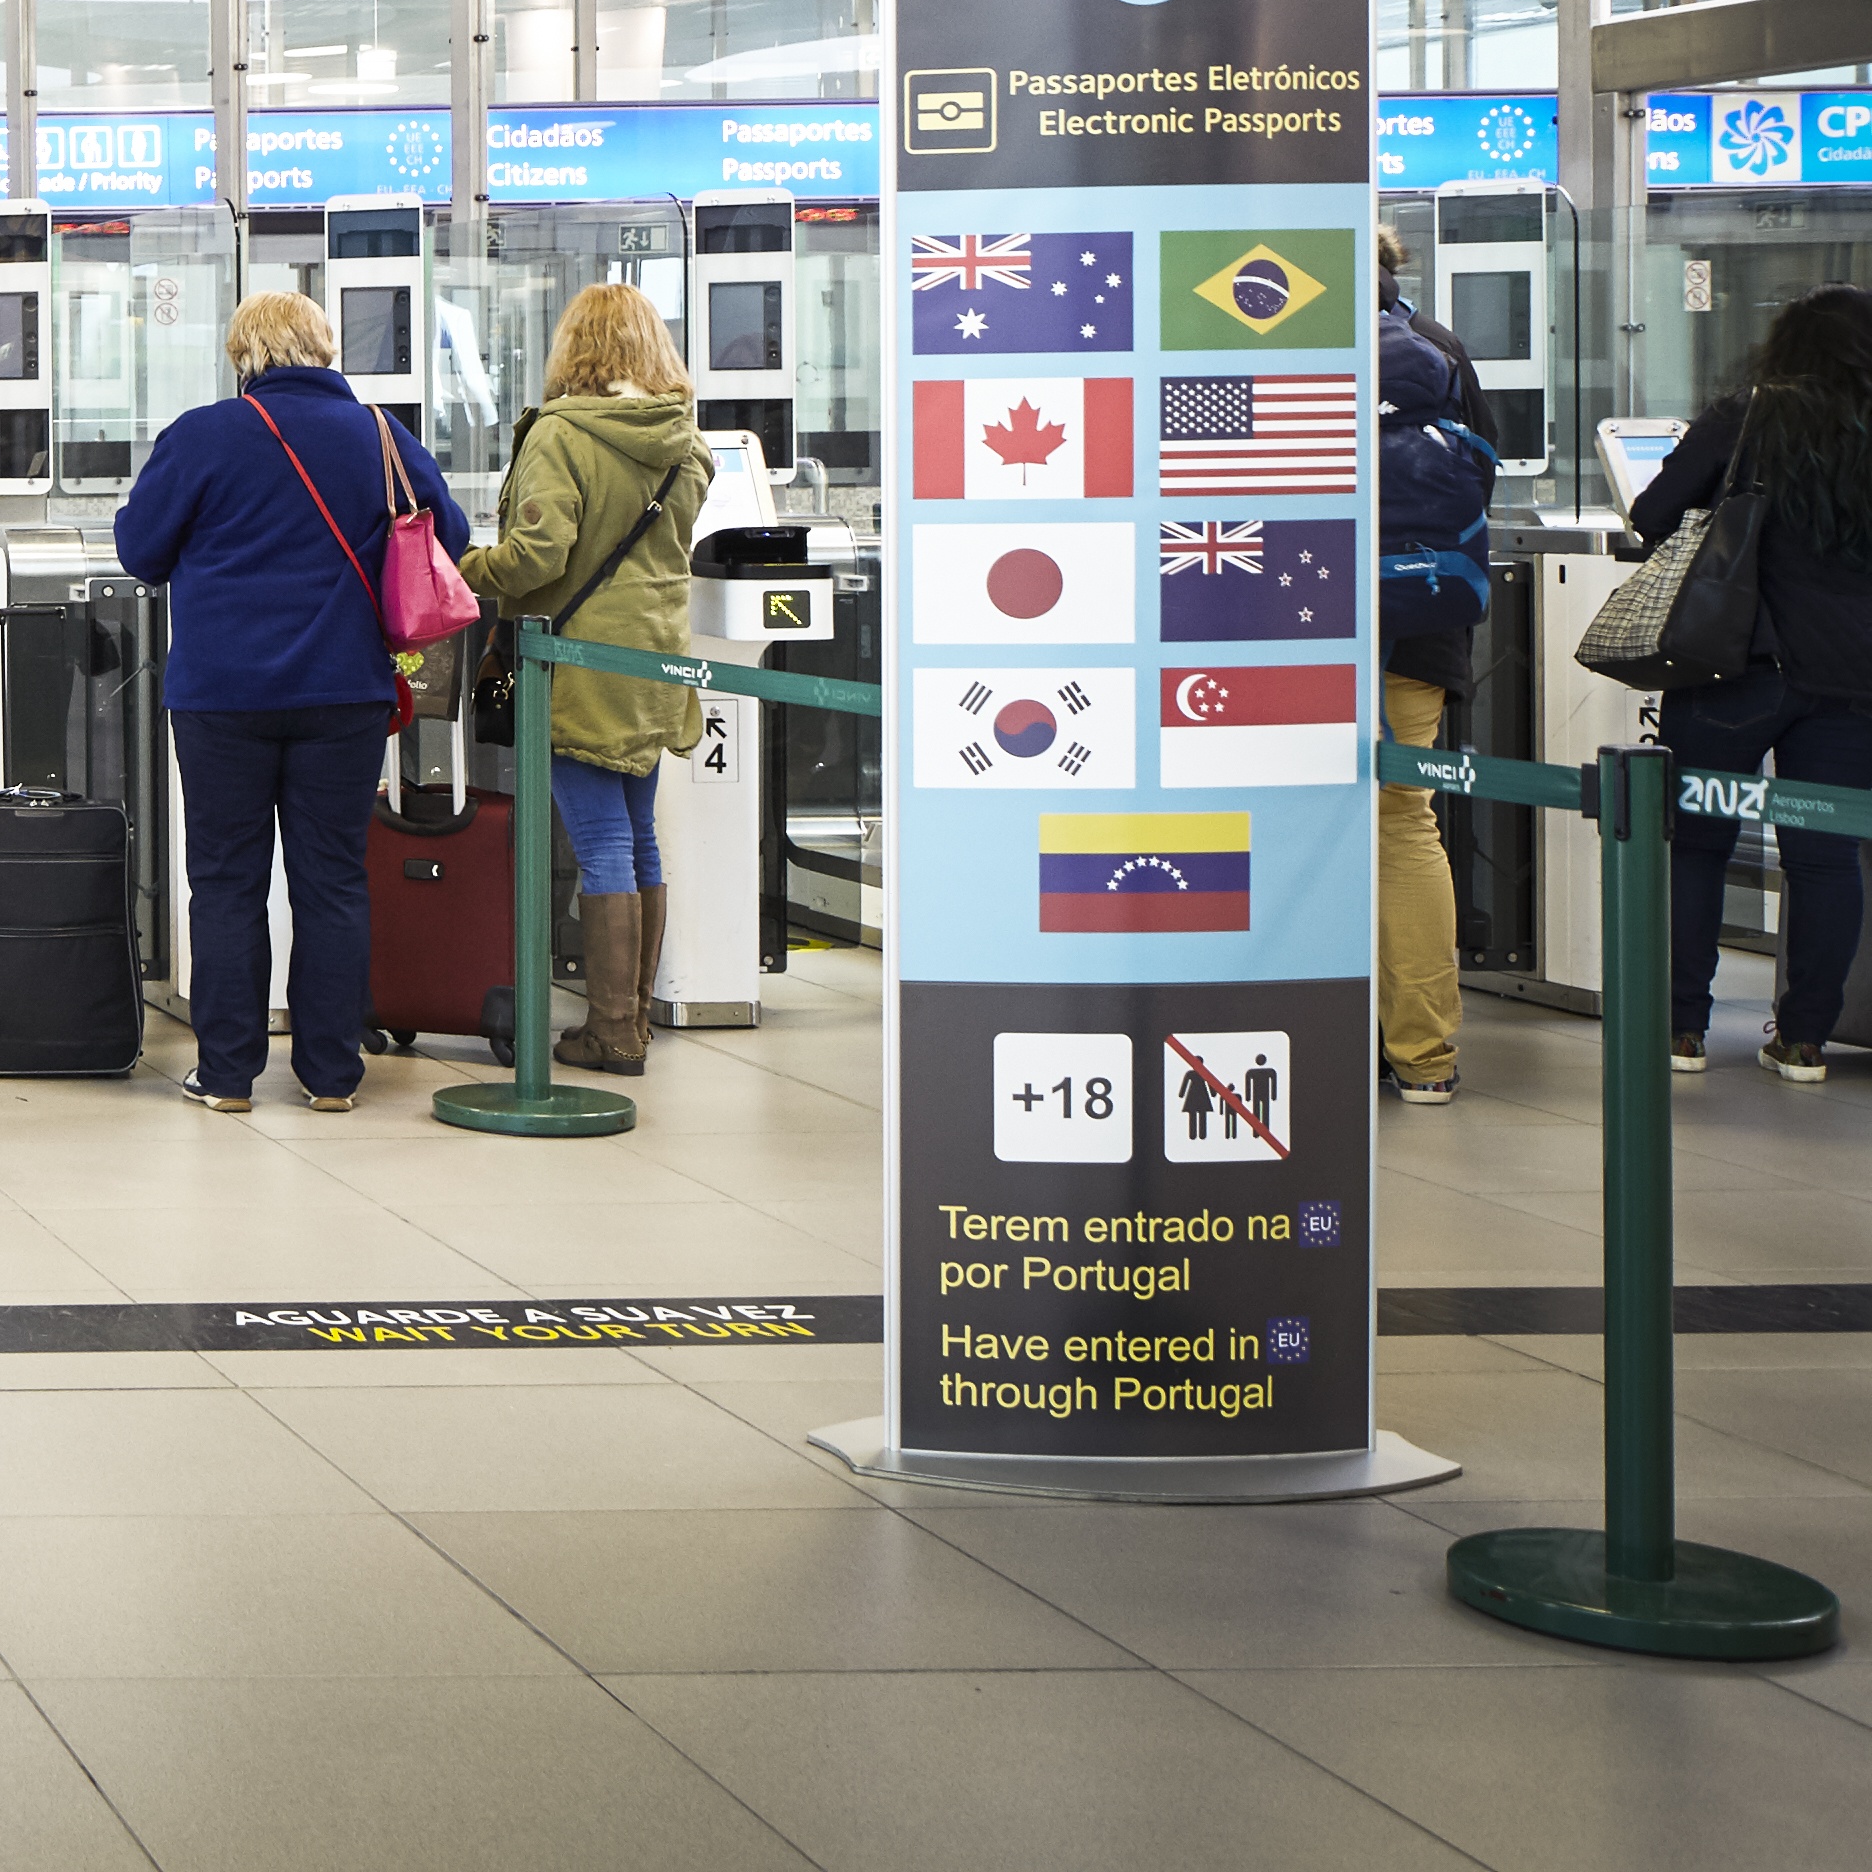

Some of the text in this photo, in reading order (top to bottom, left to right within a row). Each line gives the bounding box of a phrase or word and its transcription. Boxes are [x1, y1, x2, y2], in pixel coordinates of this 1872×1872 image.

[1009, 63, 1361, 100] Passaportes Eletrónicos
[486, 124, 604, 149] Cidadãos
[722, 119, 872, 149] Passaportes
[1039, 107, 1194, 137] Electronic
[1204, 107, 1342, 139] Passports
[1817, 105, 1872, 138] CP
[194, 127, 344, 156] Paaportes
[91, 171, 163, 195] Priority
[195, 165, 314, 195] Paports
[486, 162, 588, 188] Citizens
[722, 157, 843, 185] Passports
[661, 662, 696, 679] VINCI
[704, 743, 727, 774] 4
[1417, 761, 1456, 781] VINCI
[1771, 792, 1836, 813] Aeroportos
[1011, 1076, 1115, 1120] +18
[938, 1205, 1333, 1243] Terem entrado na EU
[939, 1256, 1191, 1301] por Portugal
[235, 1304, 816, 1325] AGUARDE A SUA VEZ
[307, 1321, 816, 1343] WAIT YOUR TURN
[941, 1323, 1300, 1363] Have entered in EU
[939, 1373, 1274, 1419] through Portugal
